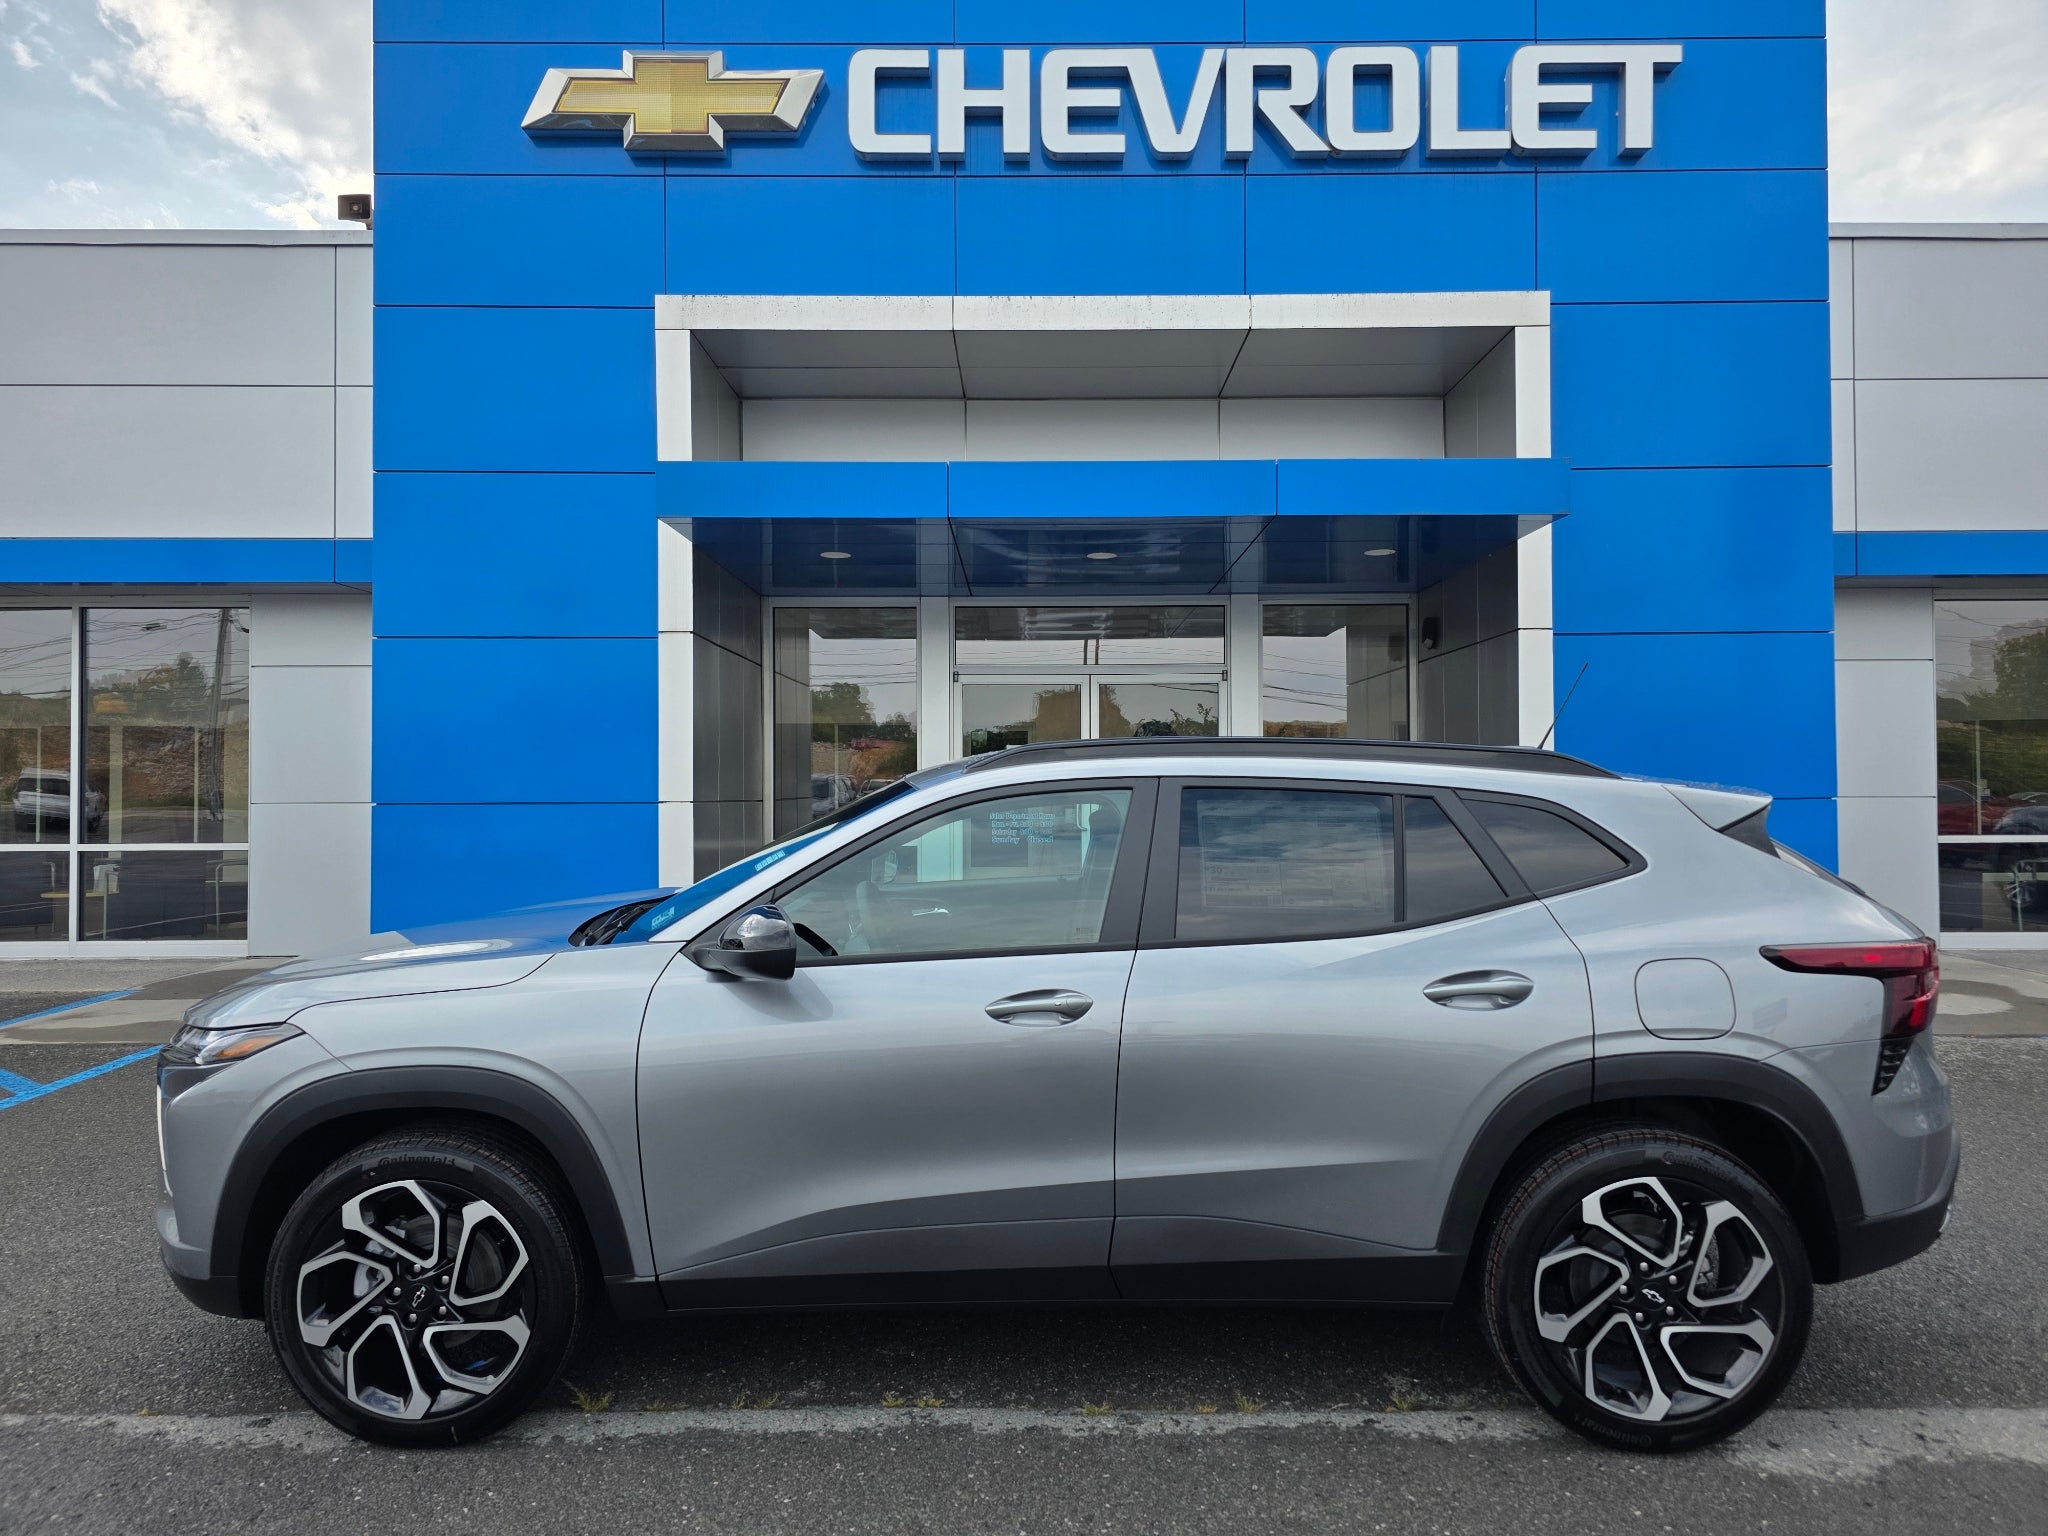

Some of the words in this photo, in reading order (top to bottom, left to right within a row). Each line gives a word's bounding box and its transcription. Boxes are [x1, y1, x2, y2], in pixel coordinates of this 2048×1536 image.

[848, 43, 1683, 156] CHEVROLET
[991, 836, 1020, 845] Sunday
[378, 1155, 448, 1169] Continental
